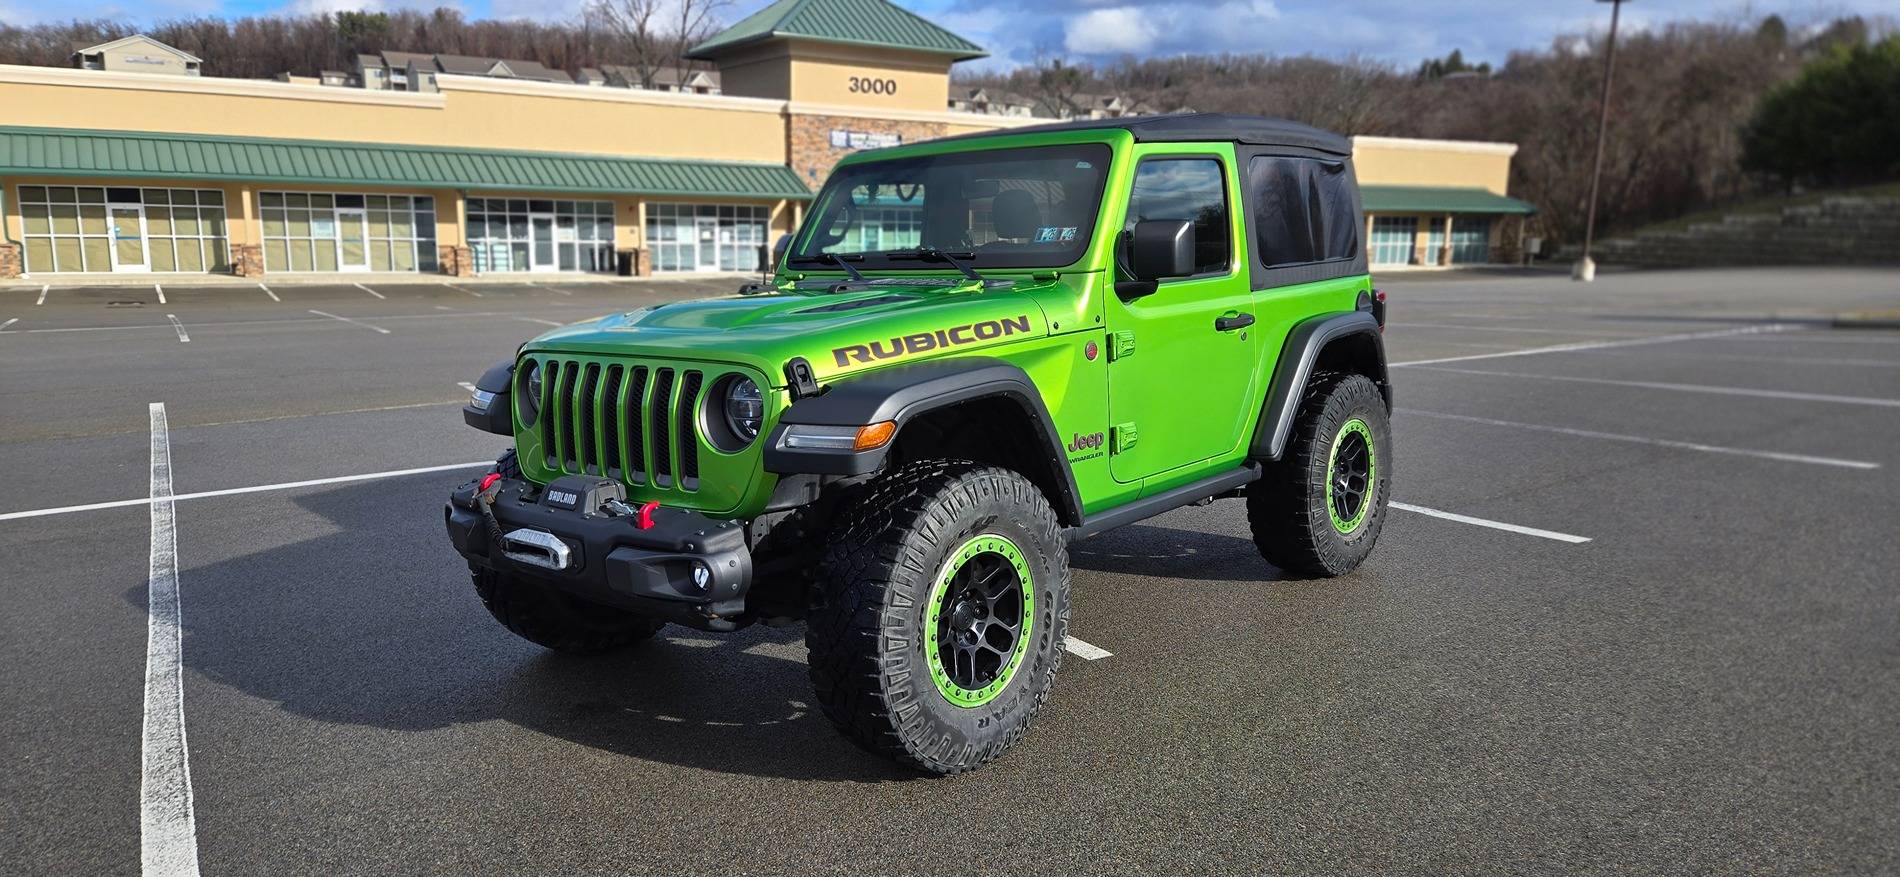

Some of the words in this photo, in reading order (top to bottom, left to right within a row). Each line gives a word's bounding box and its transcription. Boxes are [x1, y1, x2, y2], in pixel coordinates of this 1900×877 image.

[848, 76, 897, 96] 3000
[831, 314, 1031, 368] RUBICON
[1068, 431, 1104, 452] Jeep
[1069, 451, 1104, 463] WRANGLER
[548, 490, 577, 505] BADLAND
